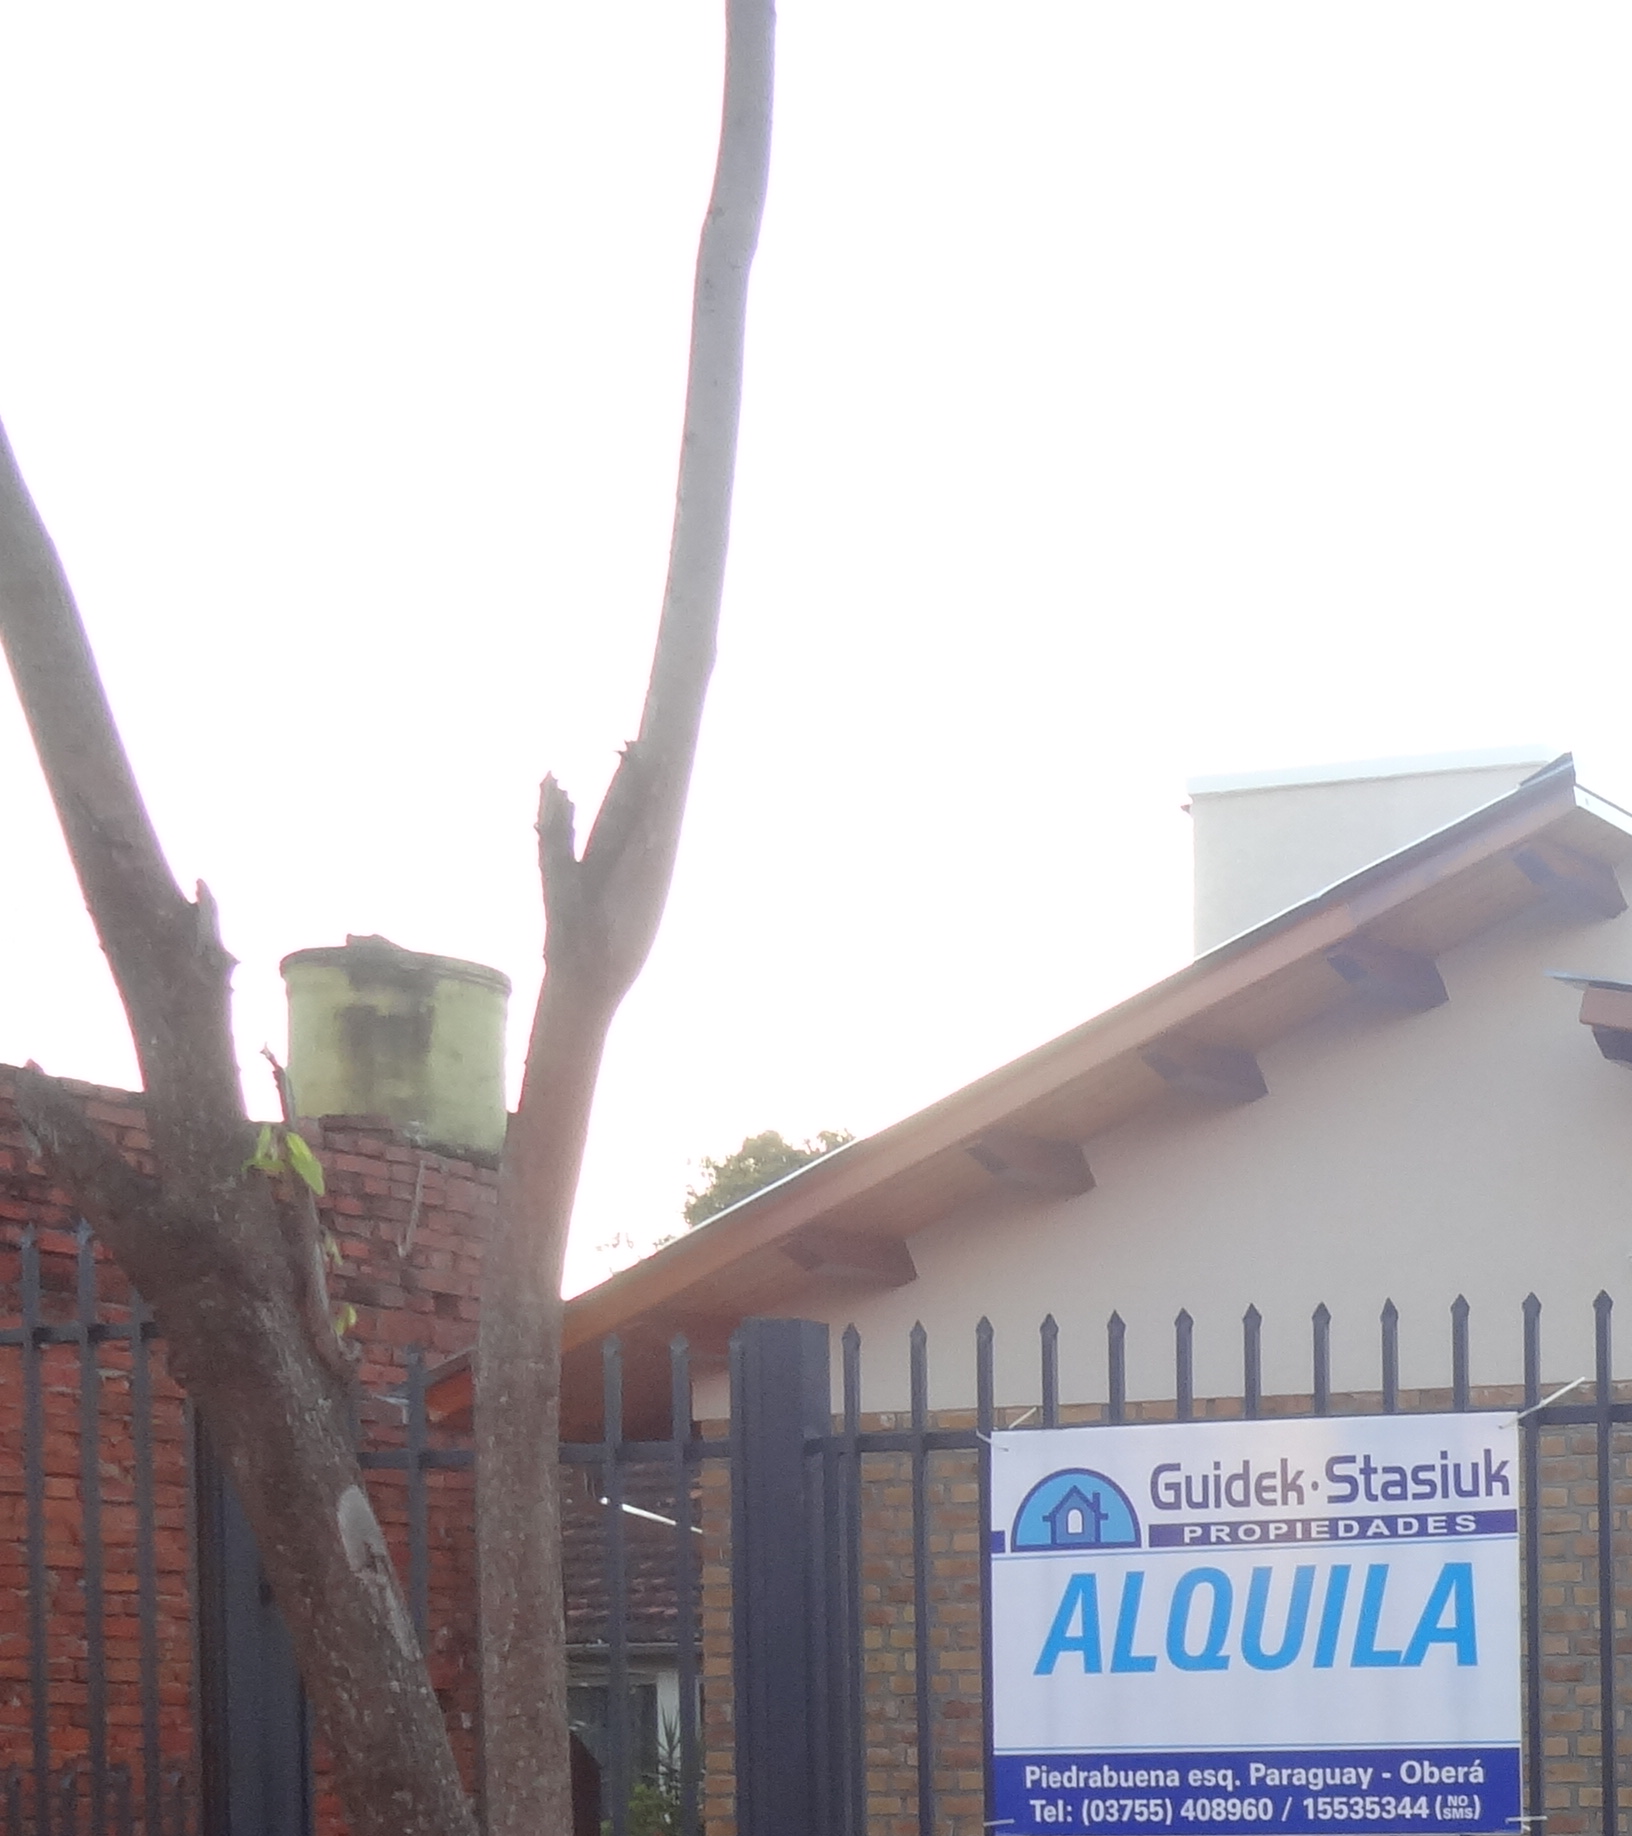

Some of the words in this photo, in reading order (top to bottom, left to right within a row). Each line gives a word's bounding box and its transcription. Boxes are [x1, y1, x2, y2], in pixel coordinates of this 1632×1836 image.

[1150, 1458, 1305, 1511] Guidek
[1326, 1448, 1511, 1504] Stasiuk
[1183, 1514, 1478, 1544] PROPIEDADES
[1033, 1562, 1479, 1676] ALQUILA
[1025, 1765, 1180, 1789] Piedrabuena
[1188, 1769, 1241, 1792] esq.
[1249, 1762, 1374, 1790] Paraguay
[1400, 1759, 1485, 1785] Oberá
[1030, 1799, 1073, 1823] Tel:
[1082, 1798, 1173, 1826] (03755)
[1180, 1797, 1274, 1822] 408960
[1303, 1795, 1430, 1821] 15535344
